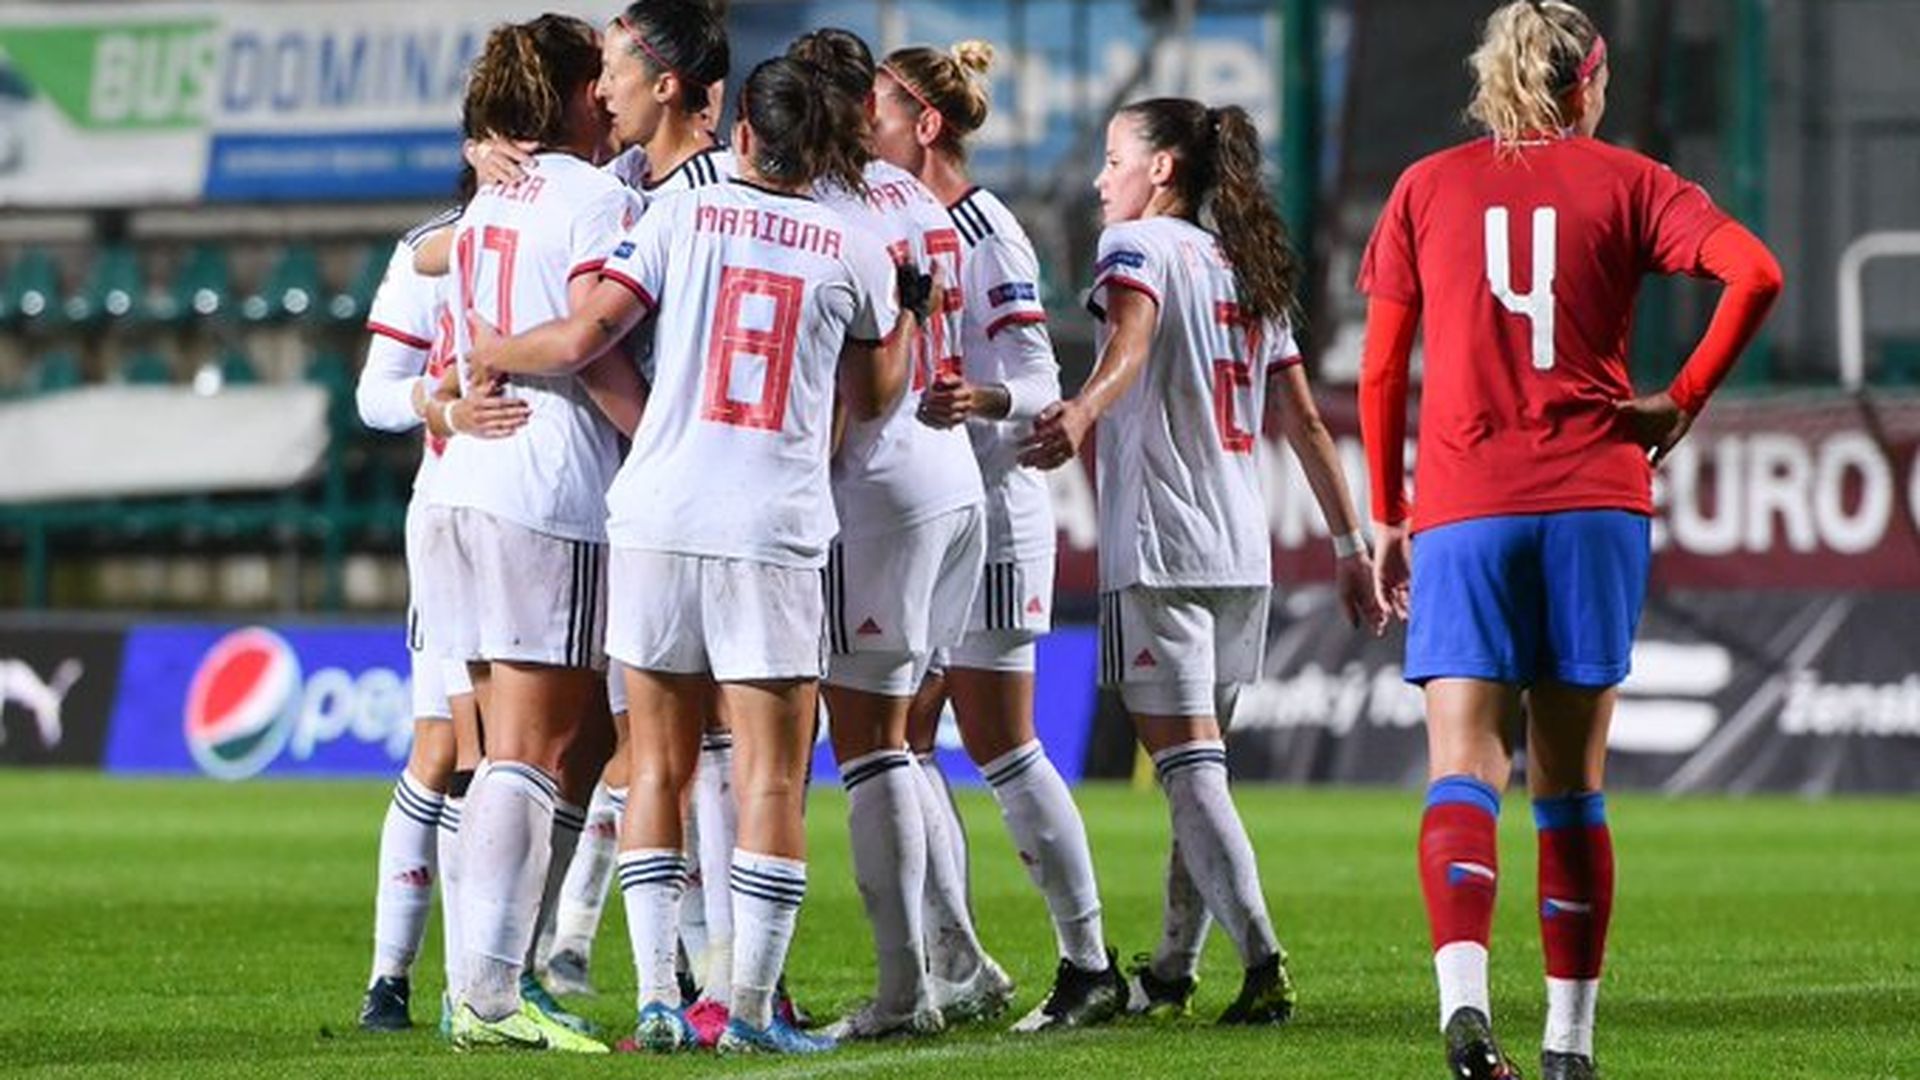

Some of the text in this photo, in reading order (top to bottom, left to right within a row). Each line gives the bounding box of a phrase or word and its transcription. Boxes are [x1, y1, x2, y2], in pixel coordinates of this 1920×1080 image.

[457, 225, 519, 345] 17
[695, 203, 842, 260] MARIONA
[1484, 206, 1557, 370] 4
[702, 265, 804, 433] 8
[1213, 300, 1262, 455] 2
